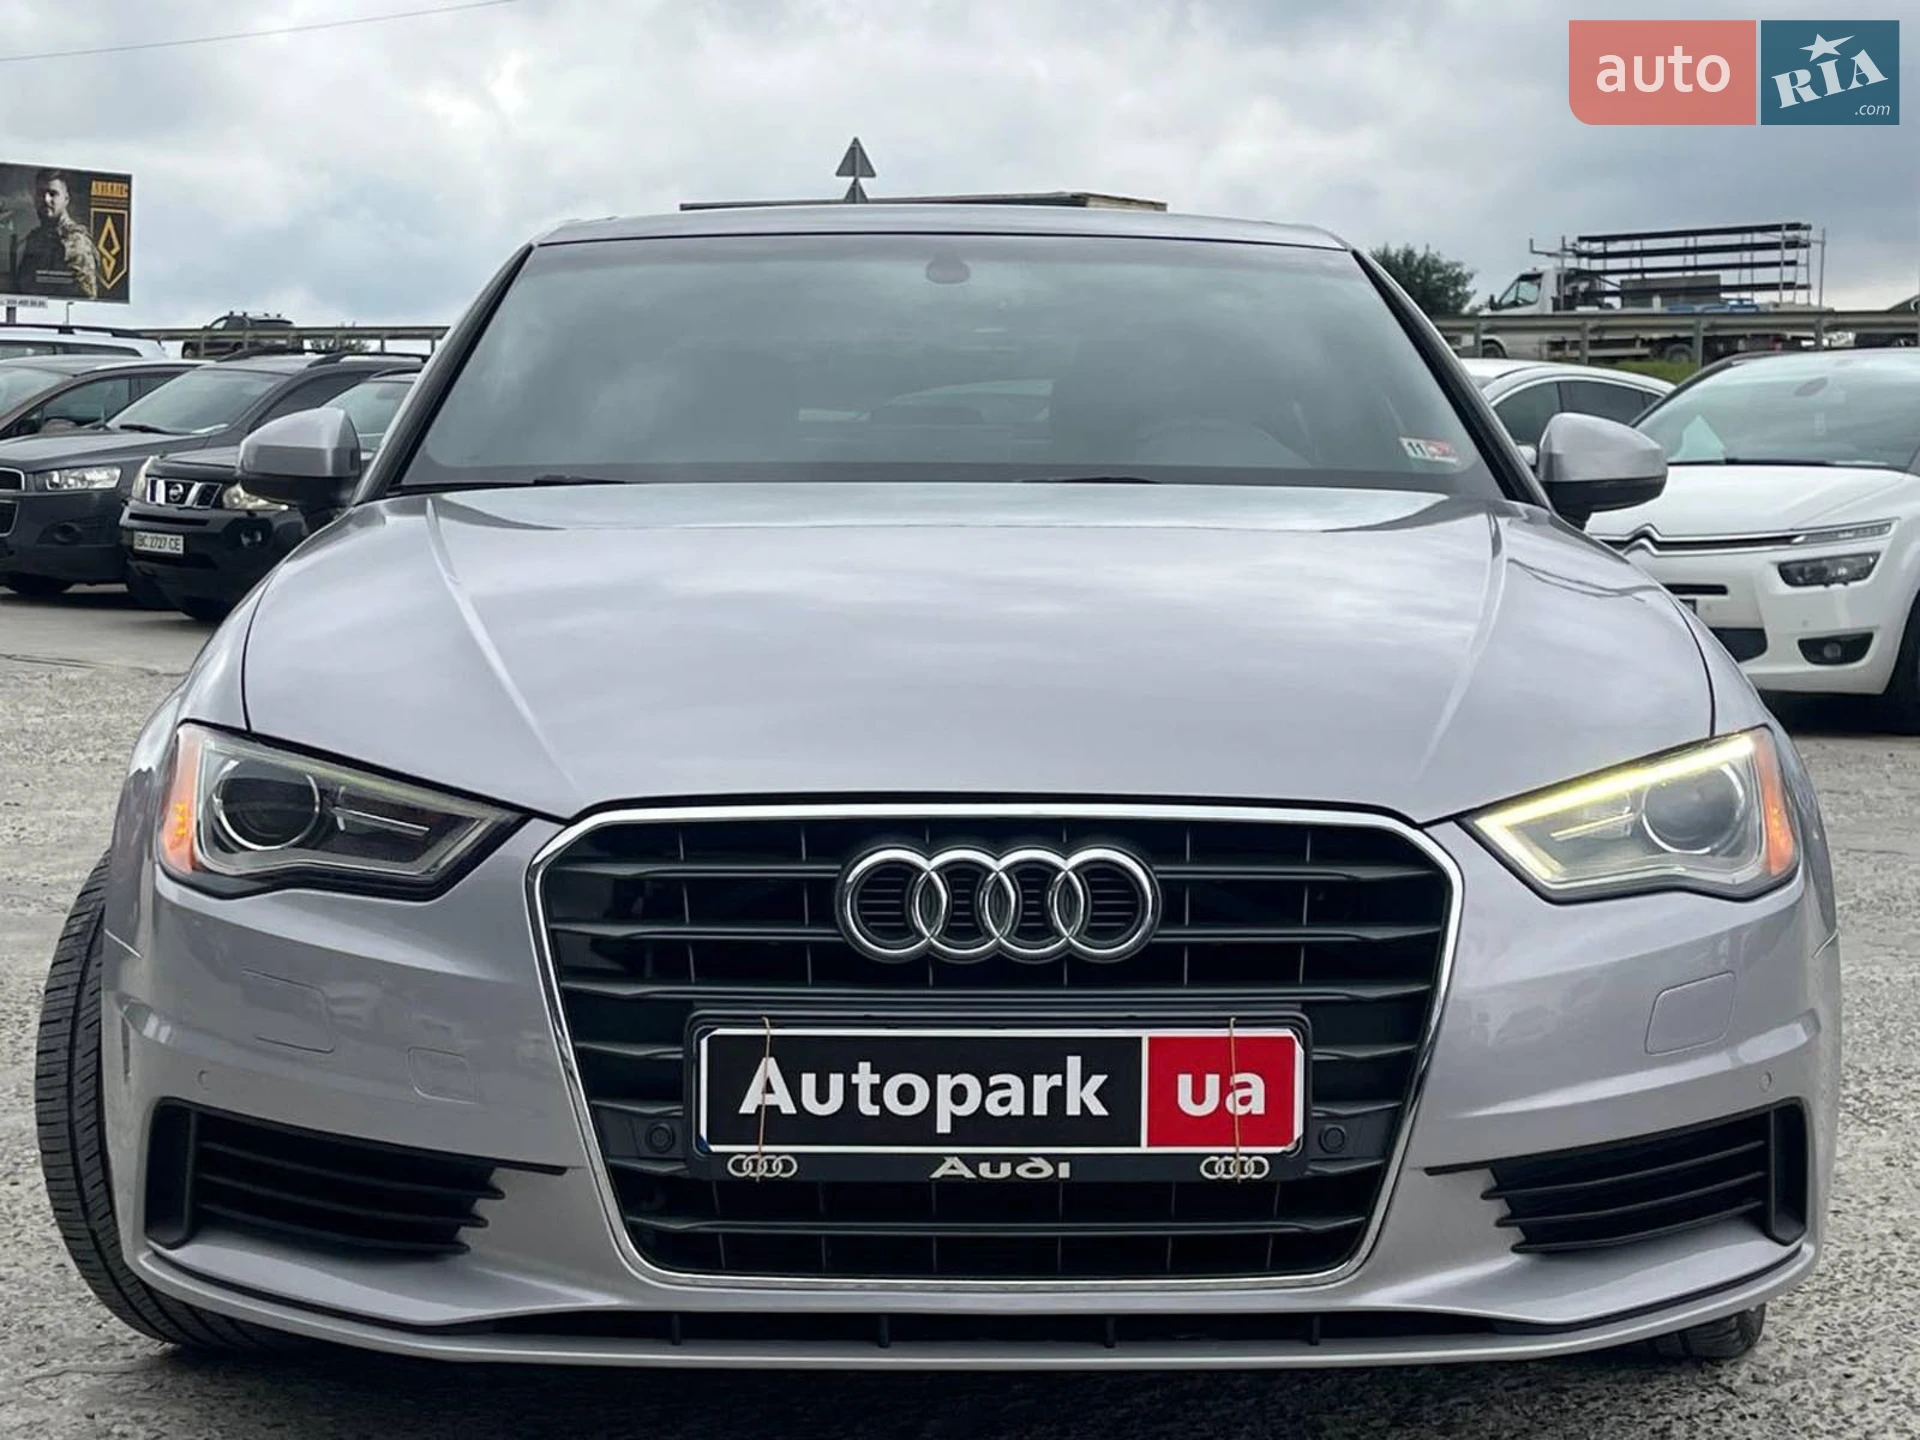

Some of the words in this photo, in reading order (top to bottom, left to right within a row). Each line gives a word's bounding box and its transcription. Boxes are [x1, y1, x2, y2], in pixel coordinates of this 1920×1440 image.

[1407, 442, 1426, 456] 11
[738, 1055, 1109, 1134] Autopark
[1177, 1072, 1266, 1117] ua
[929, 1156, 1070, 1179] Audi
